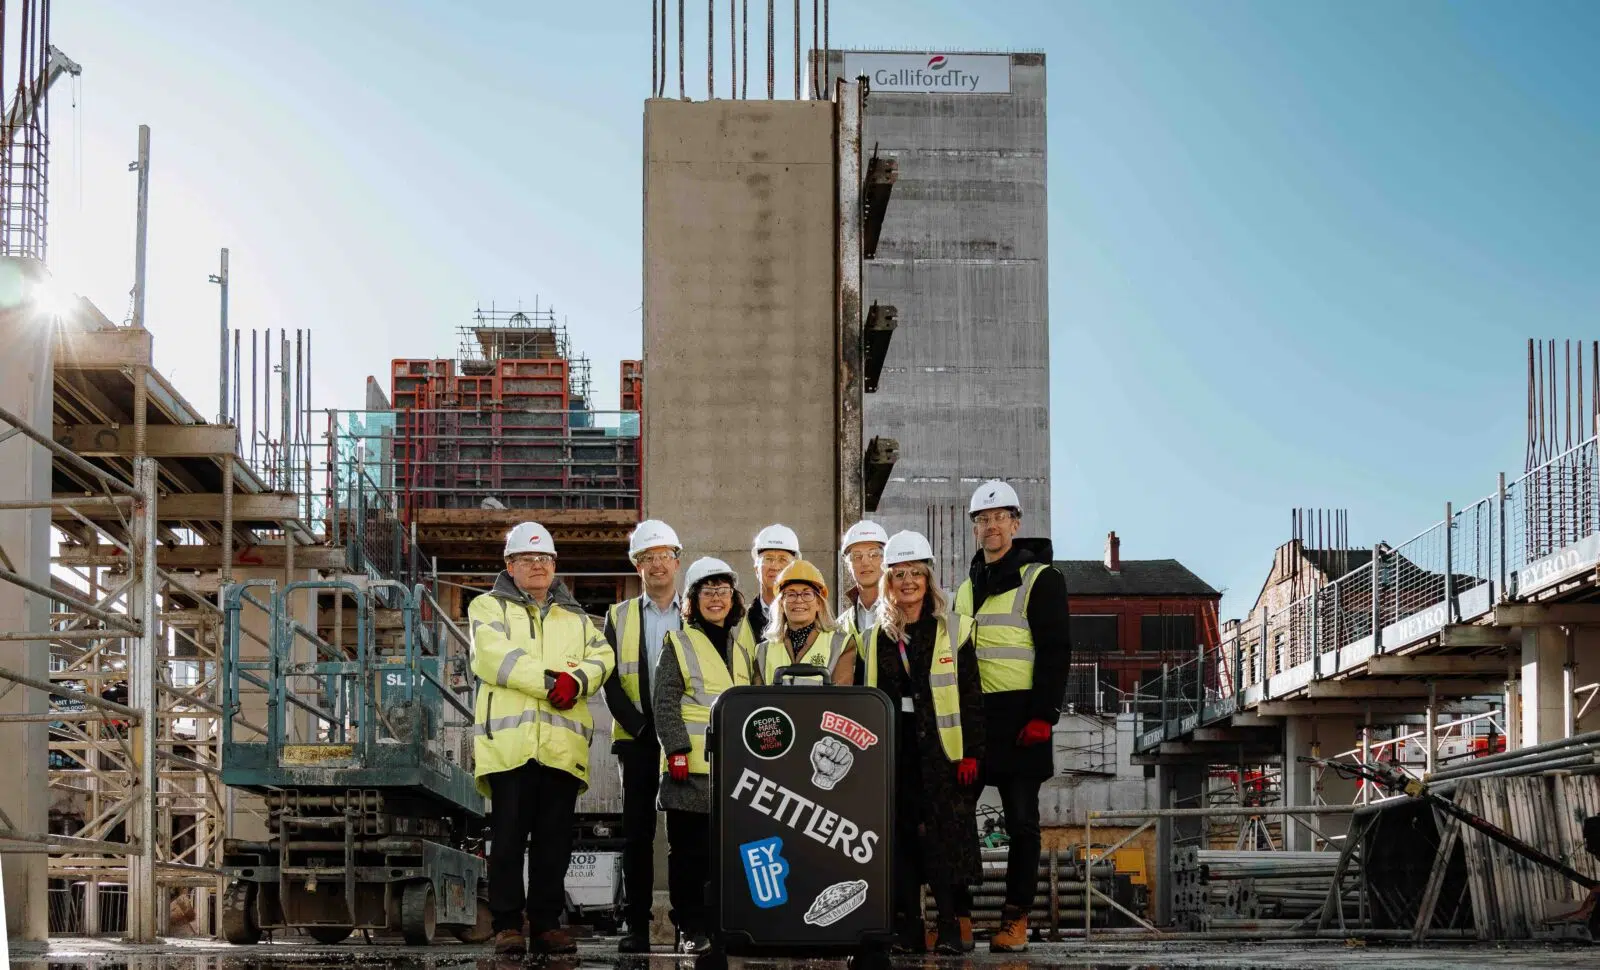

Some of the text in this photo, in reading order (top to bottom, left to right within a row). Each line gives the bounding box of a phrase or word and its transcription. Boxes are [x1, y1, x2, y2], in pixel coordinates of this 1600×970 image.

[753, 716, 781, 727] PEOPLE
[757, 723, 778, 732] MAKE
[756, 729, 783, 738] WIGAN
[730, 767, 880, 864] FETTLERS
[747, 843, 776, 867] EY
[752, 862, 783, 902] UP
